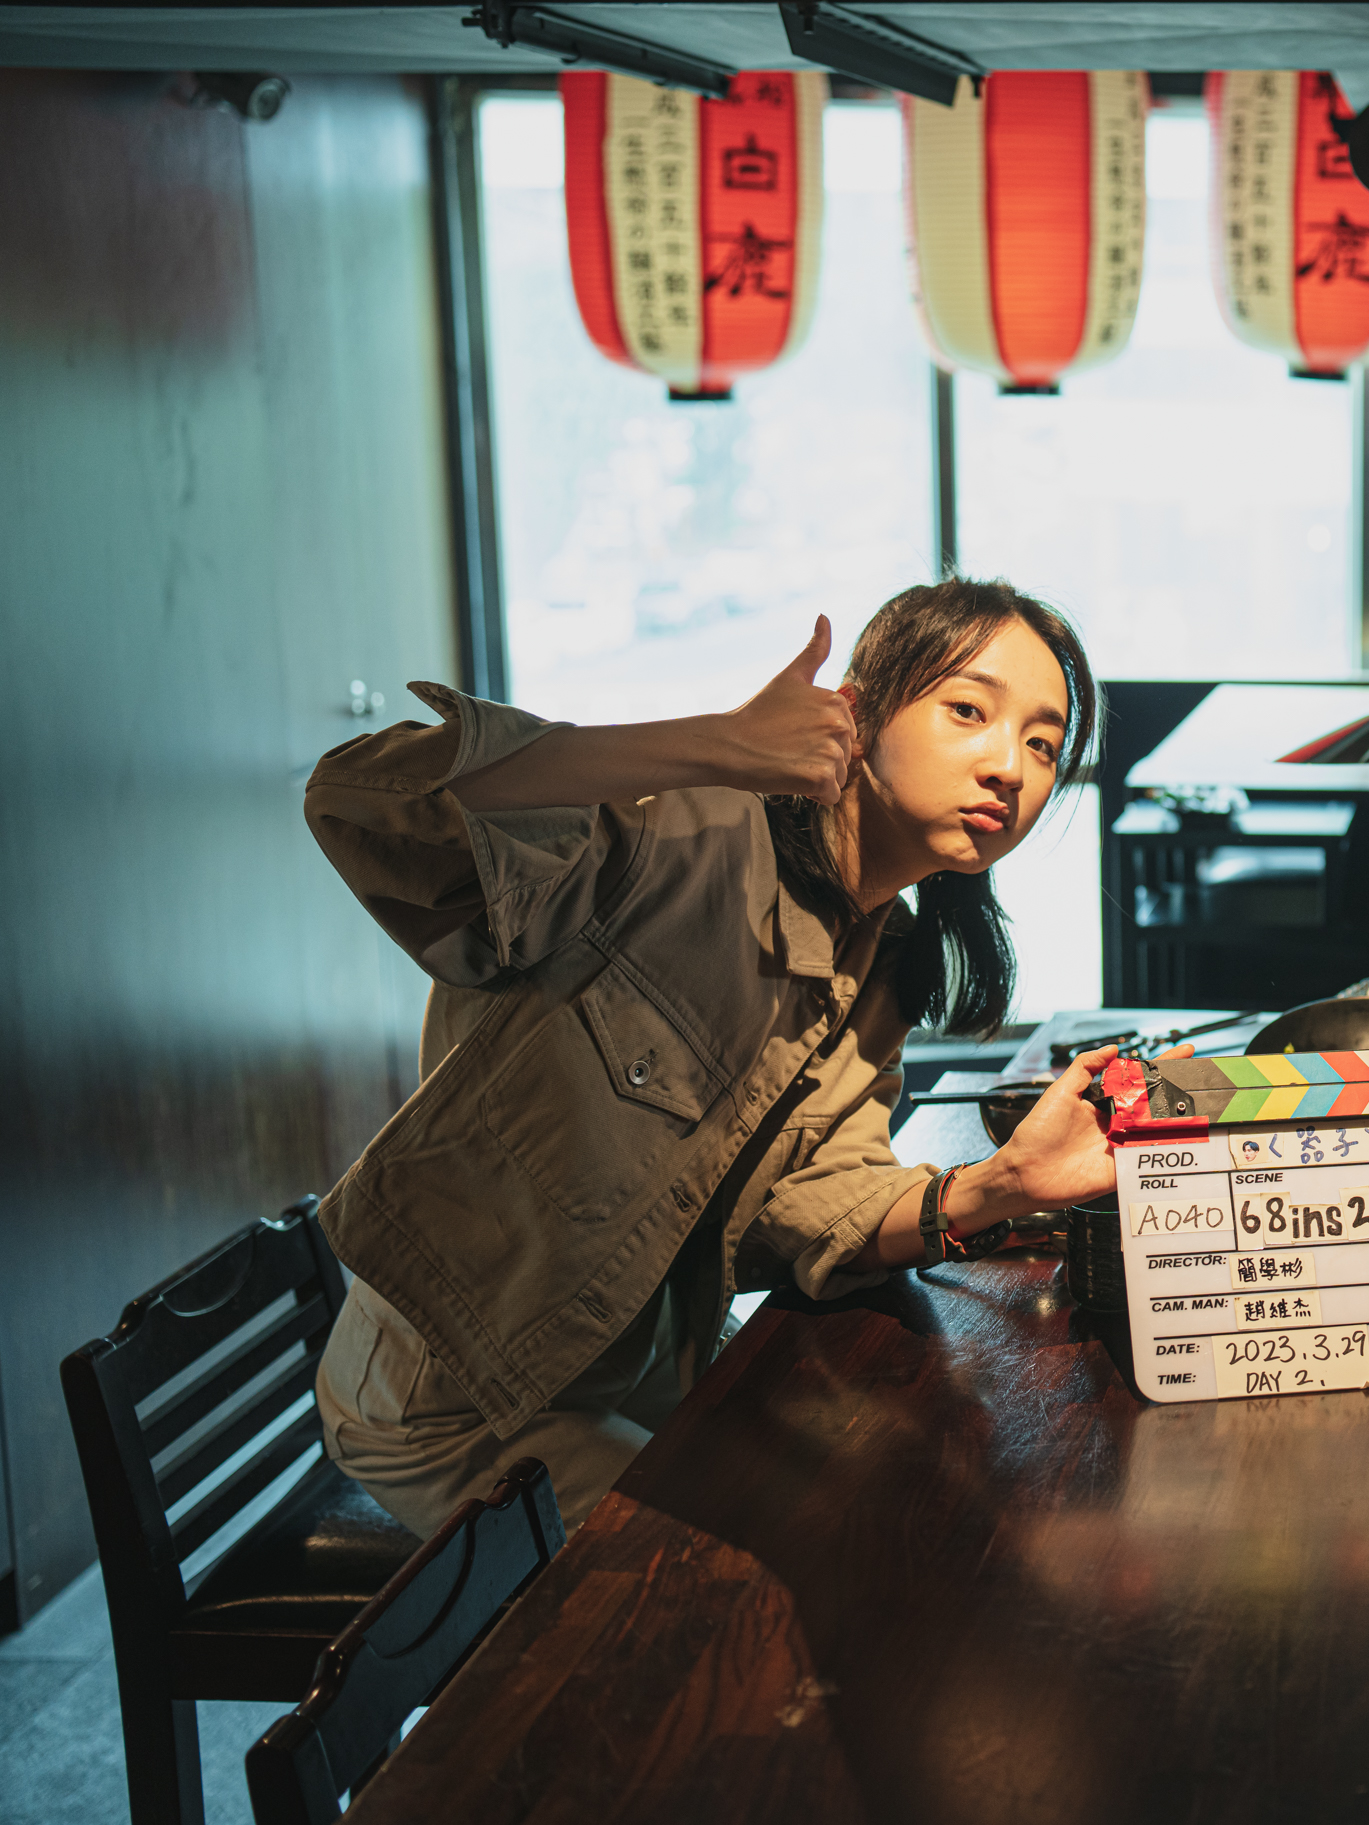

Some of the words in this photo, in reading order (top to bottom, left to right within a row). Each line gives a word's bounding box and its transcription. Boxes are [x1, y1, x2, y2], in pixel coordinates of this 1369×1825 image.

[1137, 1152, 1199, 1170] PROD.
[1140, 1178, 1179, 1190] ROLL
[1234, 1172, 1284, 1185] SCENE
[1137, 1204, 1224, 1235] A040
[1148, 1254, 1227, 1270] DIRECTOR:
[1237, 1257, 1303, 1283] 簡學彬
[1151, 1301, 1189, 1313] CAM.
[1191, 1298, 1229, 1310] MAN:
[1244, 1298, 1312, 1322] 趙維杰
[1155, 1343, 1200, 1356] DATE:
[1157, 1372, 1197, 1385] TIME:
[1246, 1370, 1283, 1394] DAY
